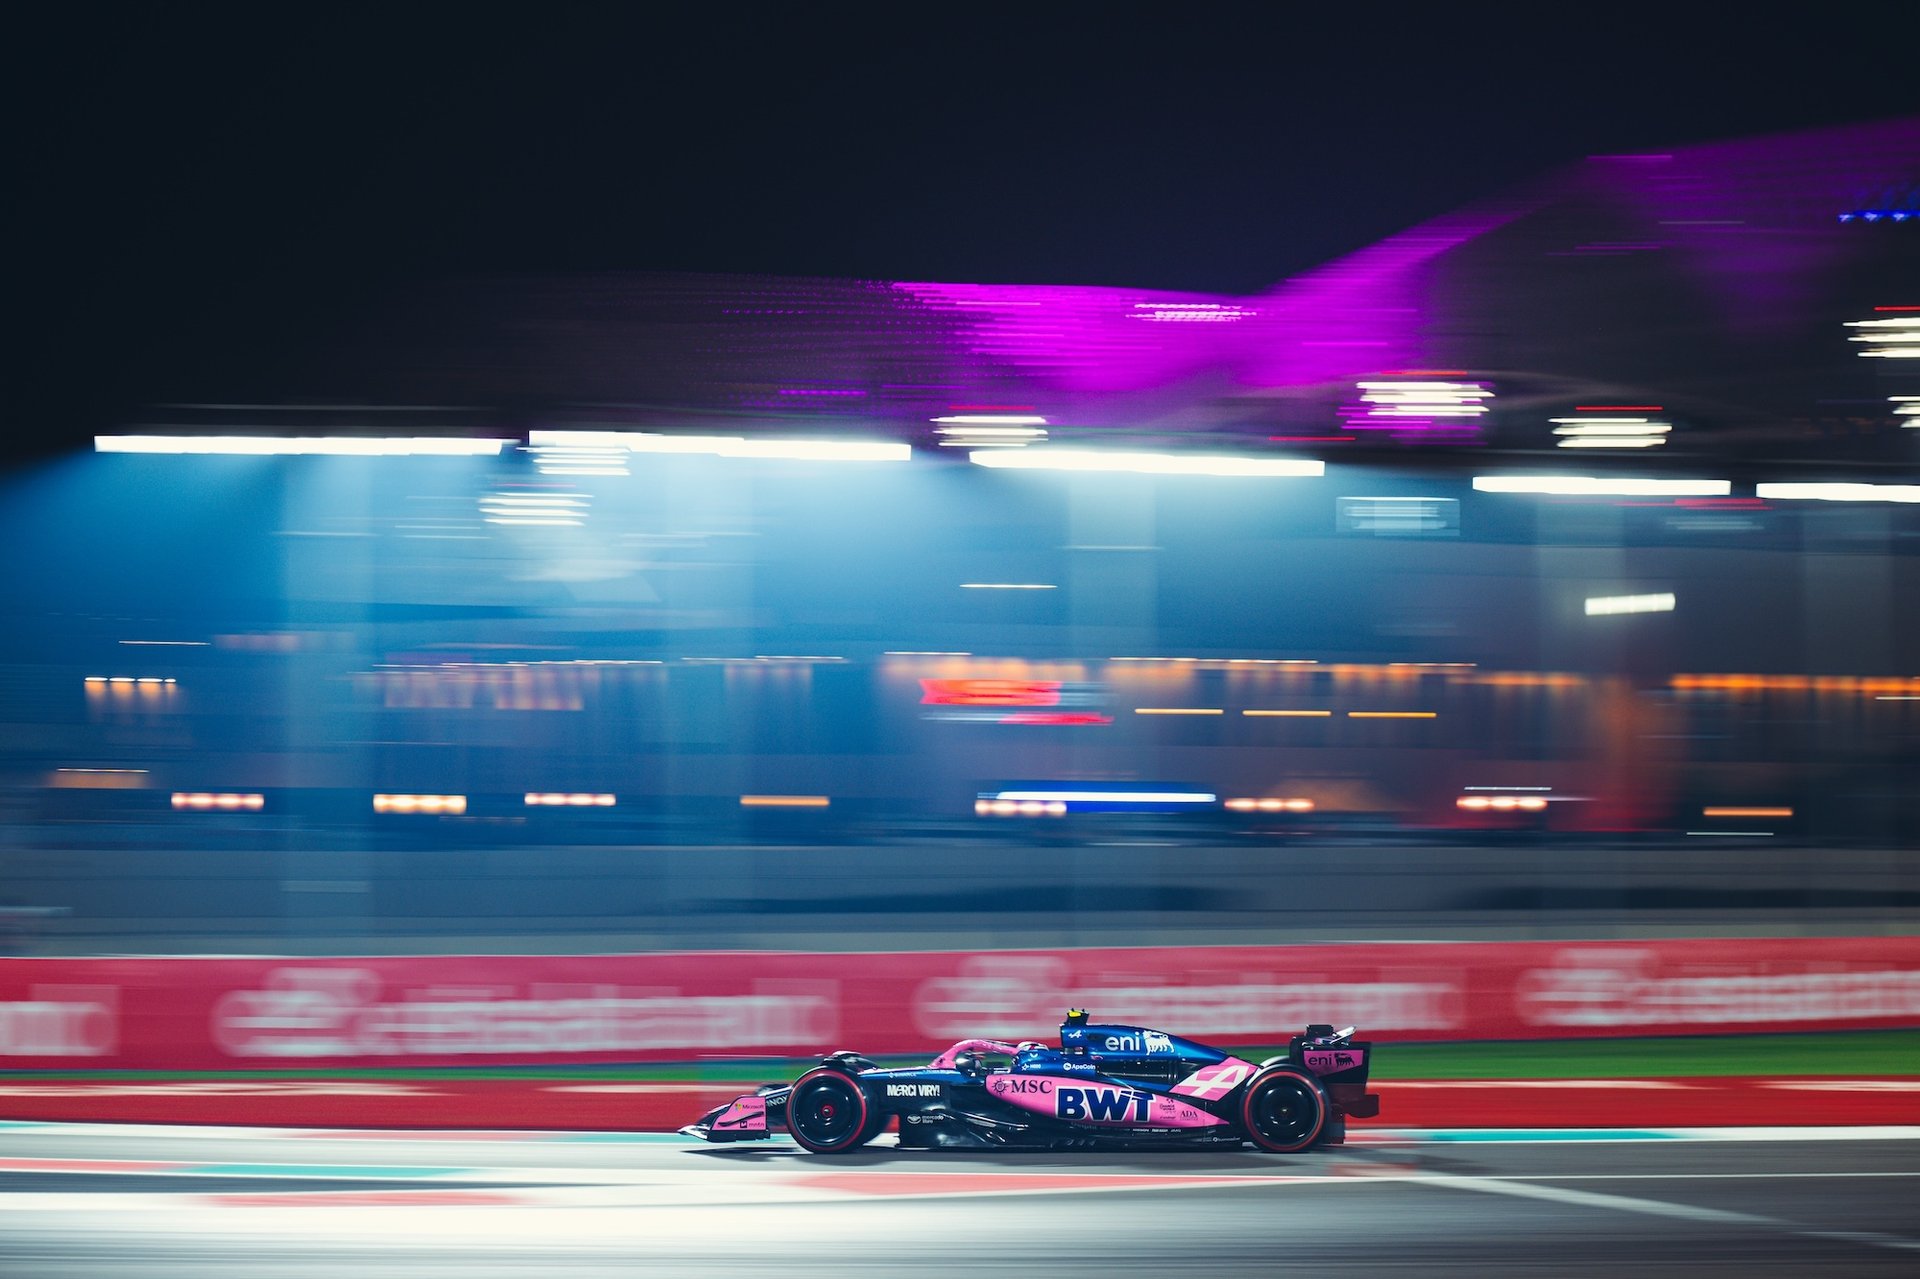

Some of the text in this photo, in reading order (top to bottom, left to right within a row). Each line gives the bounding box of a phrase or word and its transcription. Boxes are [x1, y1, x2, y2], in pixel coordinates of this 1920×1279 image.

[1105, 1031, 1141, 1051] eni
[1308, 1053, 1332, 1065] eni
[917, 1084, 941, 1097] VIRY!
[1011, 1080, 1052, 1094] MSC
[1057, 1087, 1155, 1122] BWT
[1180, 1110, 1198, 1118] ADA
